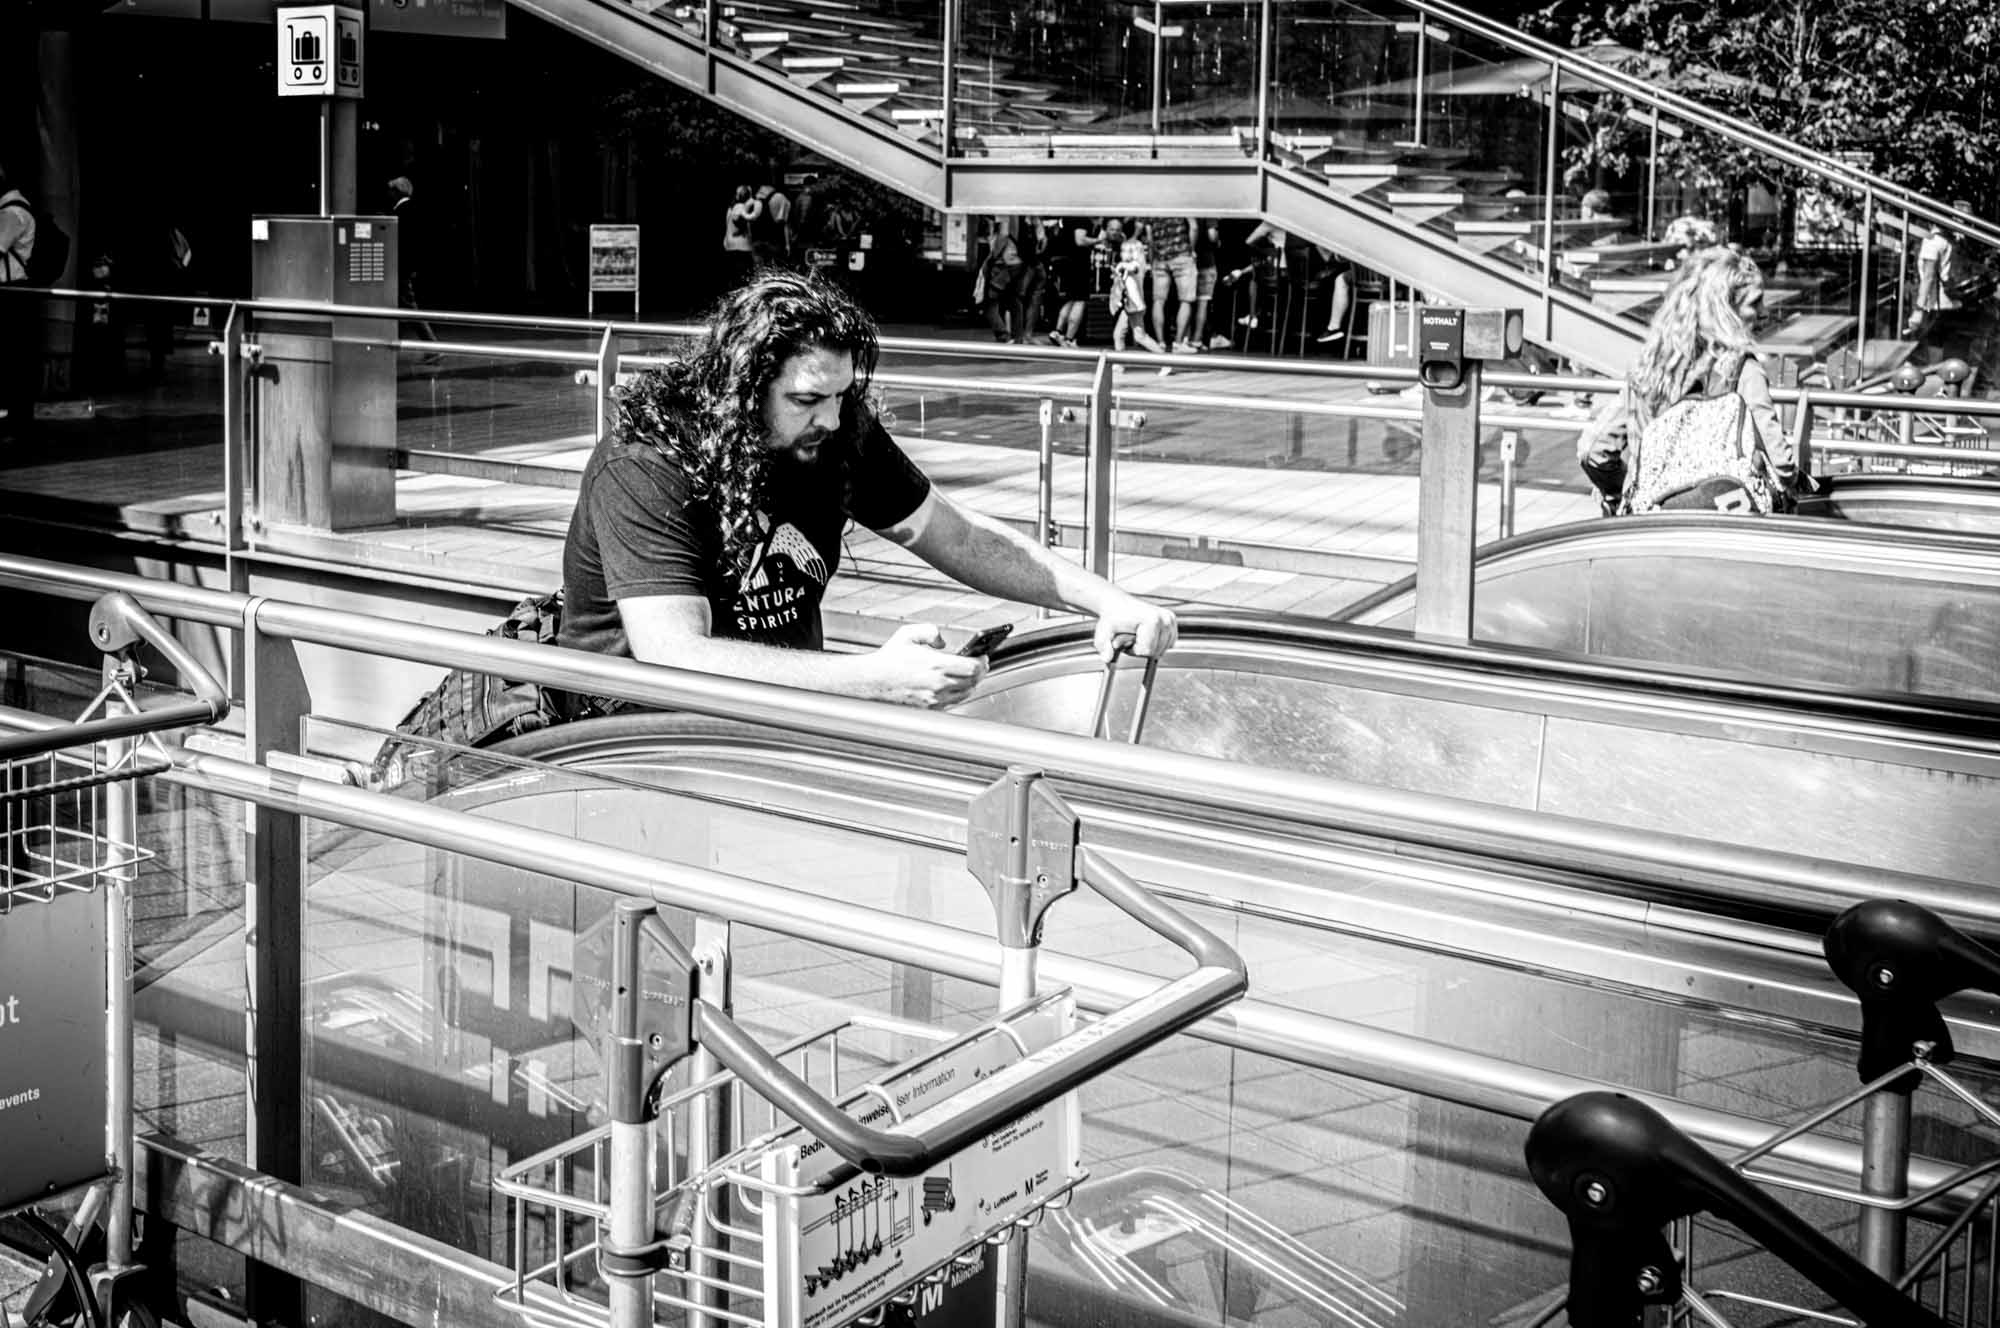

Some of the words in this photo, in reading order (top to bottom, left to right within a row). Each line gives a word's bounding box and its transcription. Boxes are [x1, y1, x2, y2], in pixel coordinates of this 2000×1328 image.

[1423, 316, 1458, 326] NOTHALT
[737, 606, 798, 631] SPIRITS
[921, 1283, 943, 1317] M
